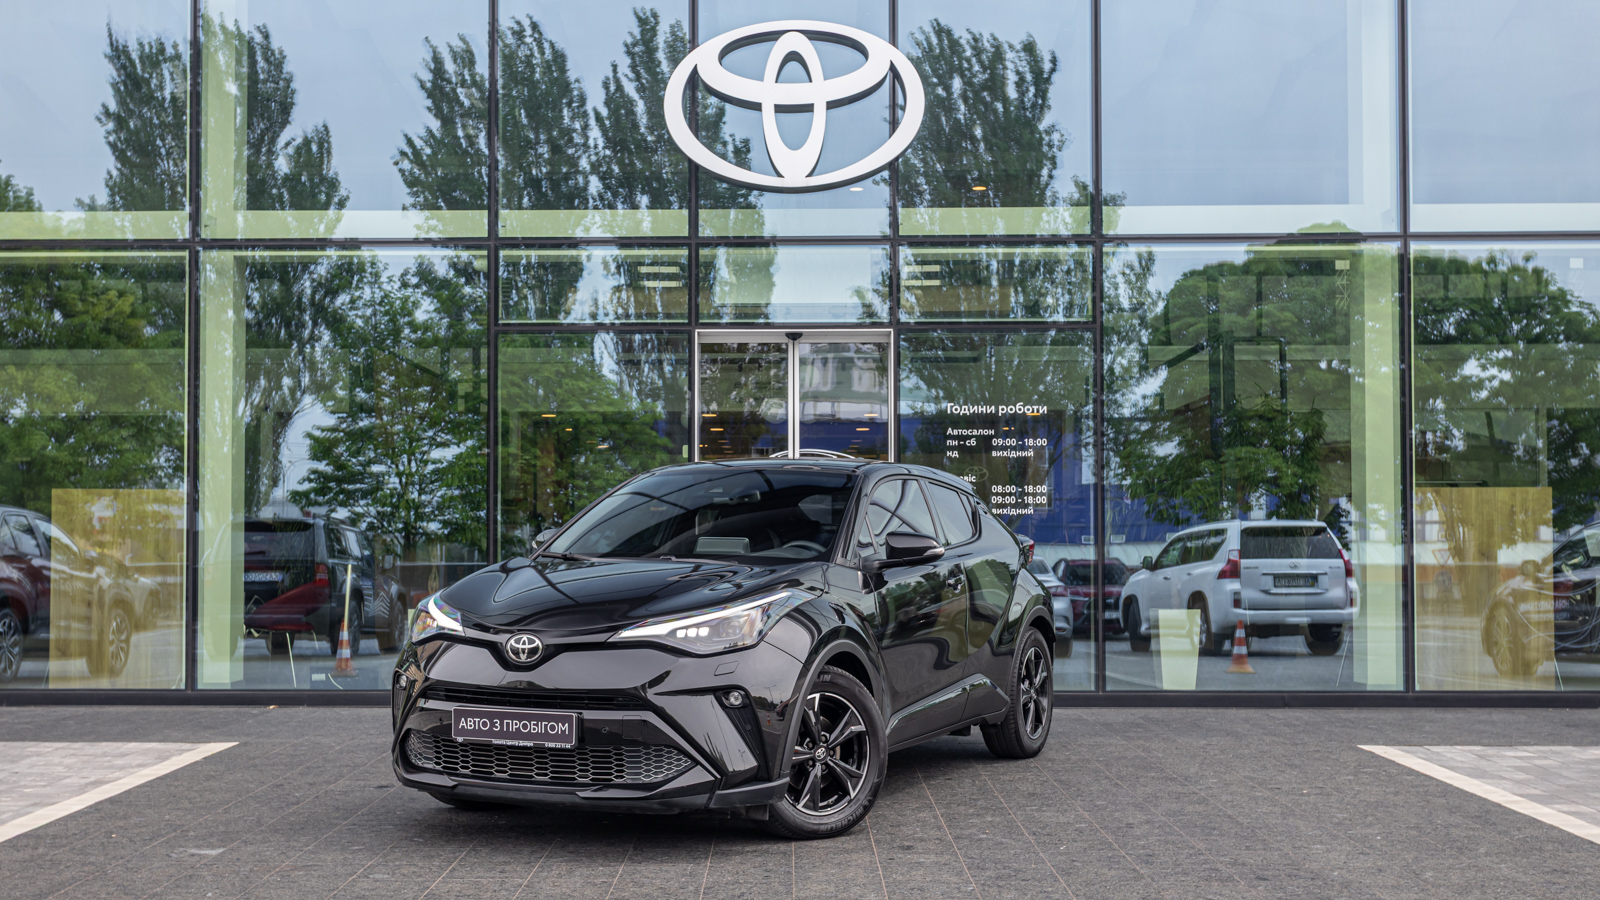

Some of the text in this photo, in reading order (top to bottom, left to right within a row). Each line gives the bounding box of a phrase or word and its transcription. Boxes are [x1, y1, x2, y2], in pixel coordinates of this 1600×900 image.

[947, 402, 1048, 416] Години роботи
[946, 427, 995, 436] Автосалон
[965, 438, 977, 446] сб
[991, 438, 1017, 446] 09:00
[1024, 438, 1048, 446] 18:00
[946, 450, 959, 458] нд
[991, 448, 1034, 458] вихідний
[991, 485, 1017, 493] 08:00
[1023, 485, 1047, 493] 18:00
[991, 495, 1017, 504] 09:00
[1023, 495, 1047, 504] 18:00
[991, 506, 1034, 516] вихідний
[458, 717, 490, 731] АВТО
[503, 719, 569, 735] ПРОБІГОМ
[820, 804, 865, 832] MICHELIN
